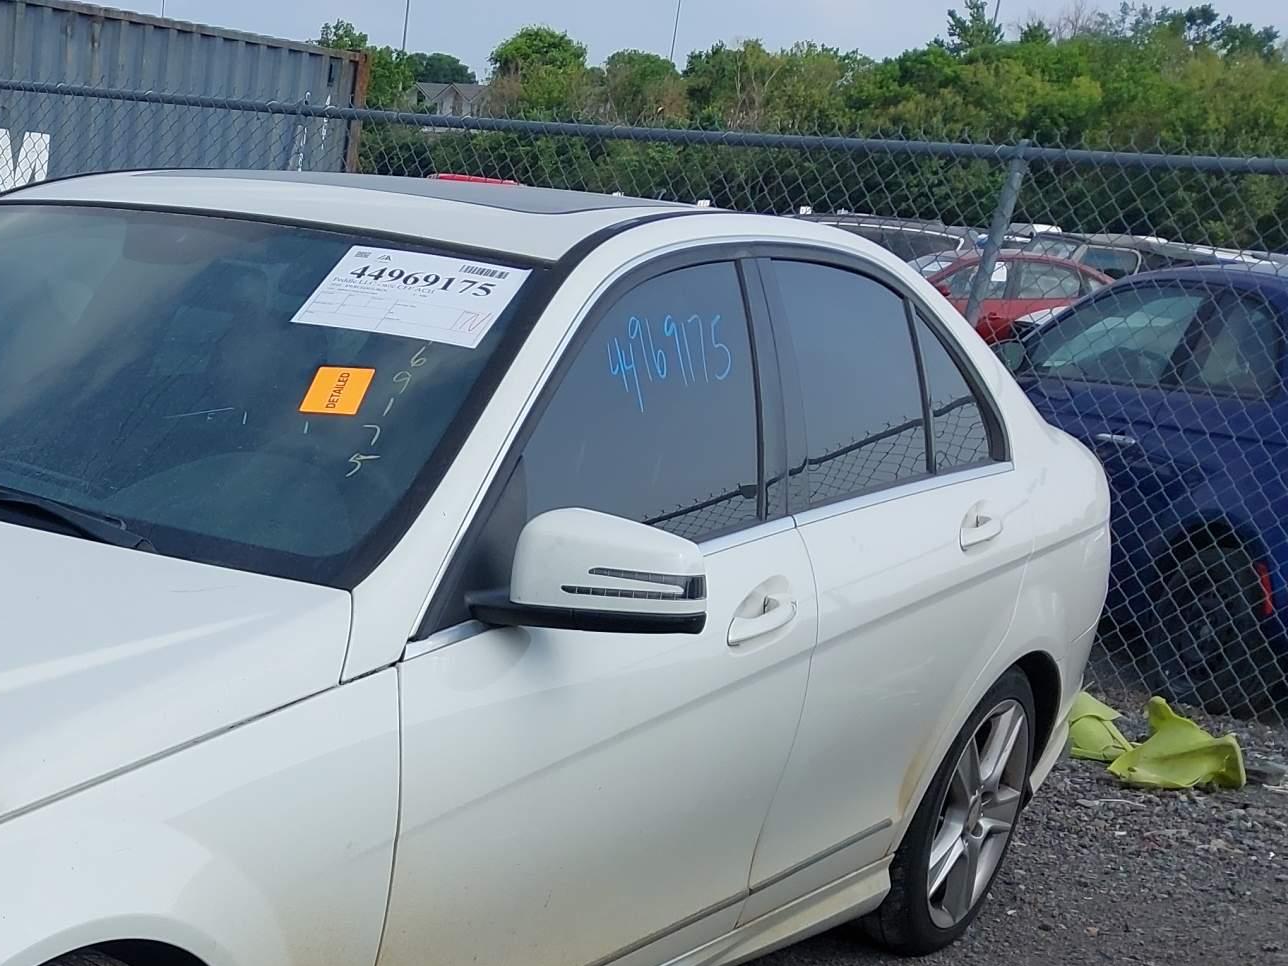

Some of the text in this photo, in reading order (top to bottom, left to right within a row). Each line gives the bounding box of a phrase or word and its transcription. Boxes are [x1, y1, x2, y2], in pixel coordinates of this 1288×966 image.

[350, 264, 497, 297] 44969175
[607, 314, 732, 413] 44969175
[325, 371, 350, 409] DETAILED
